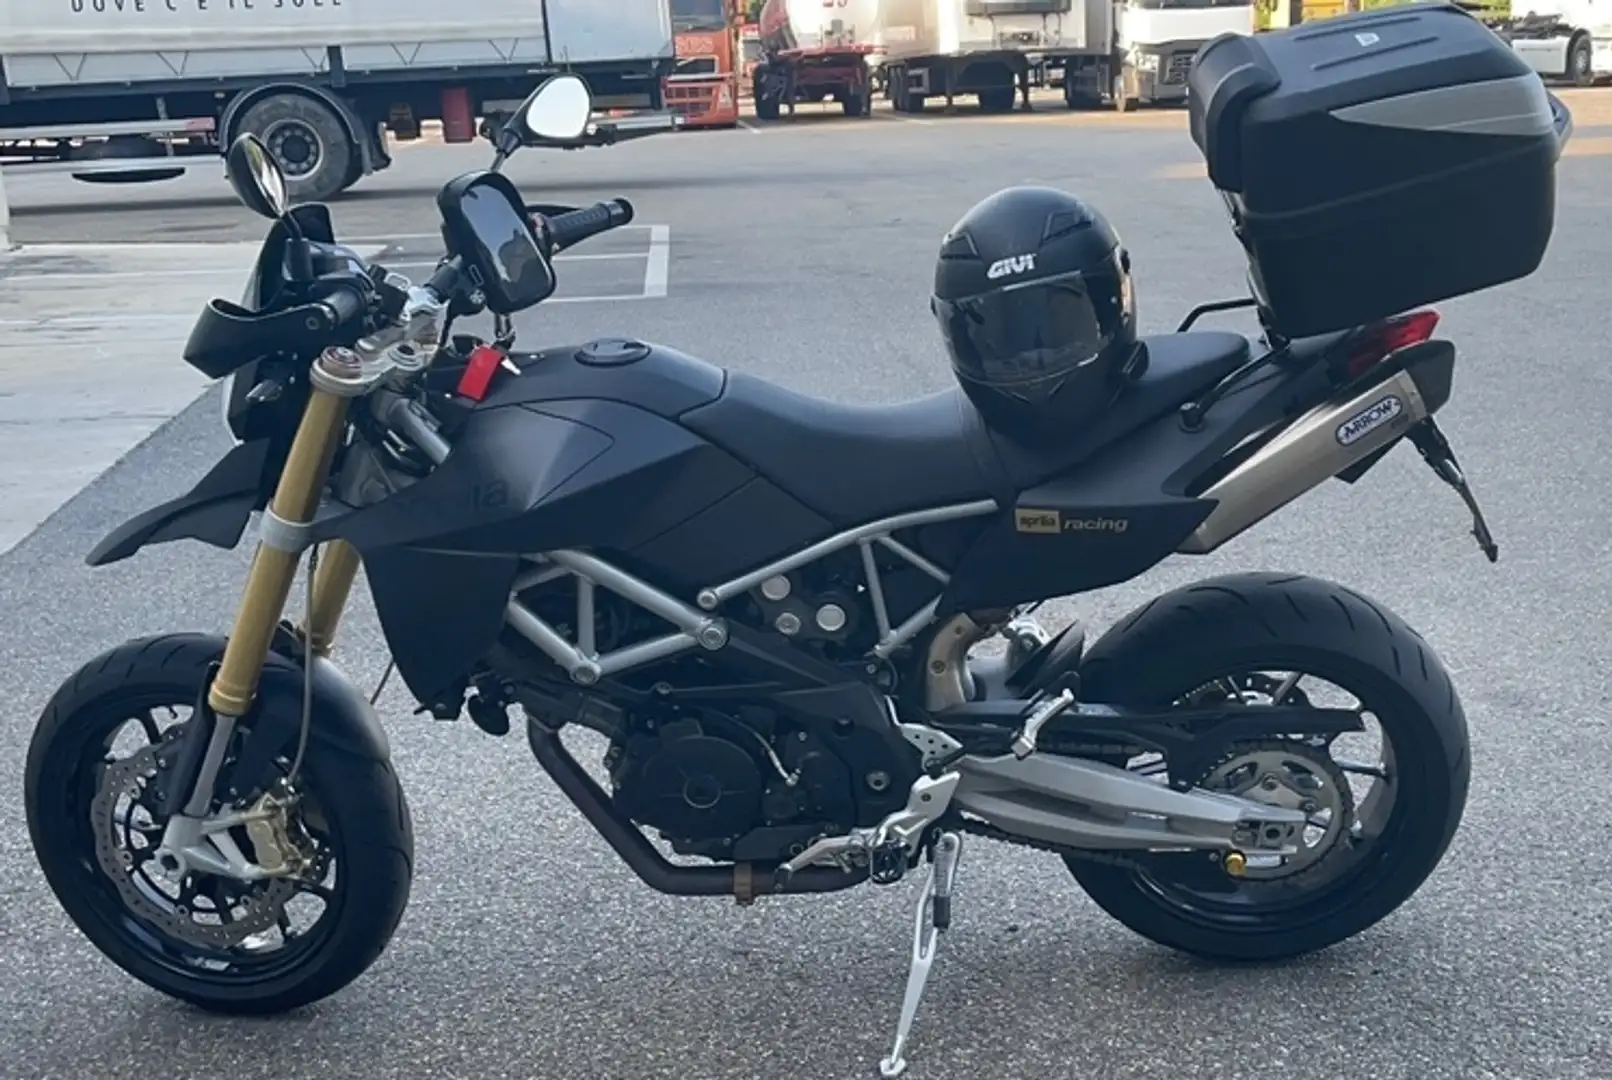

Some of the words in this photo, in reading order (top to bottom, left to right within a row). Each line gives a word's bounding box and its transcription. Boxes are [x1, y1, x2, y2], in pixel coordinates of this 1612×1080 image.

[986, 252, 1037, 280] GIVI
[1343, 400, 1395, 439] ARROW
[1063, 517, 1129, 534] racing
